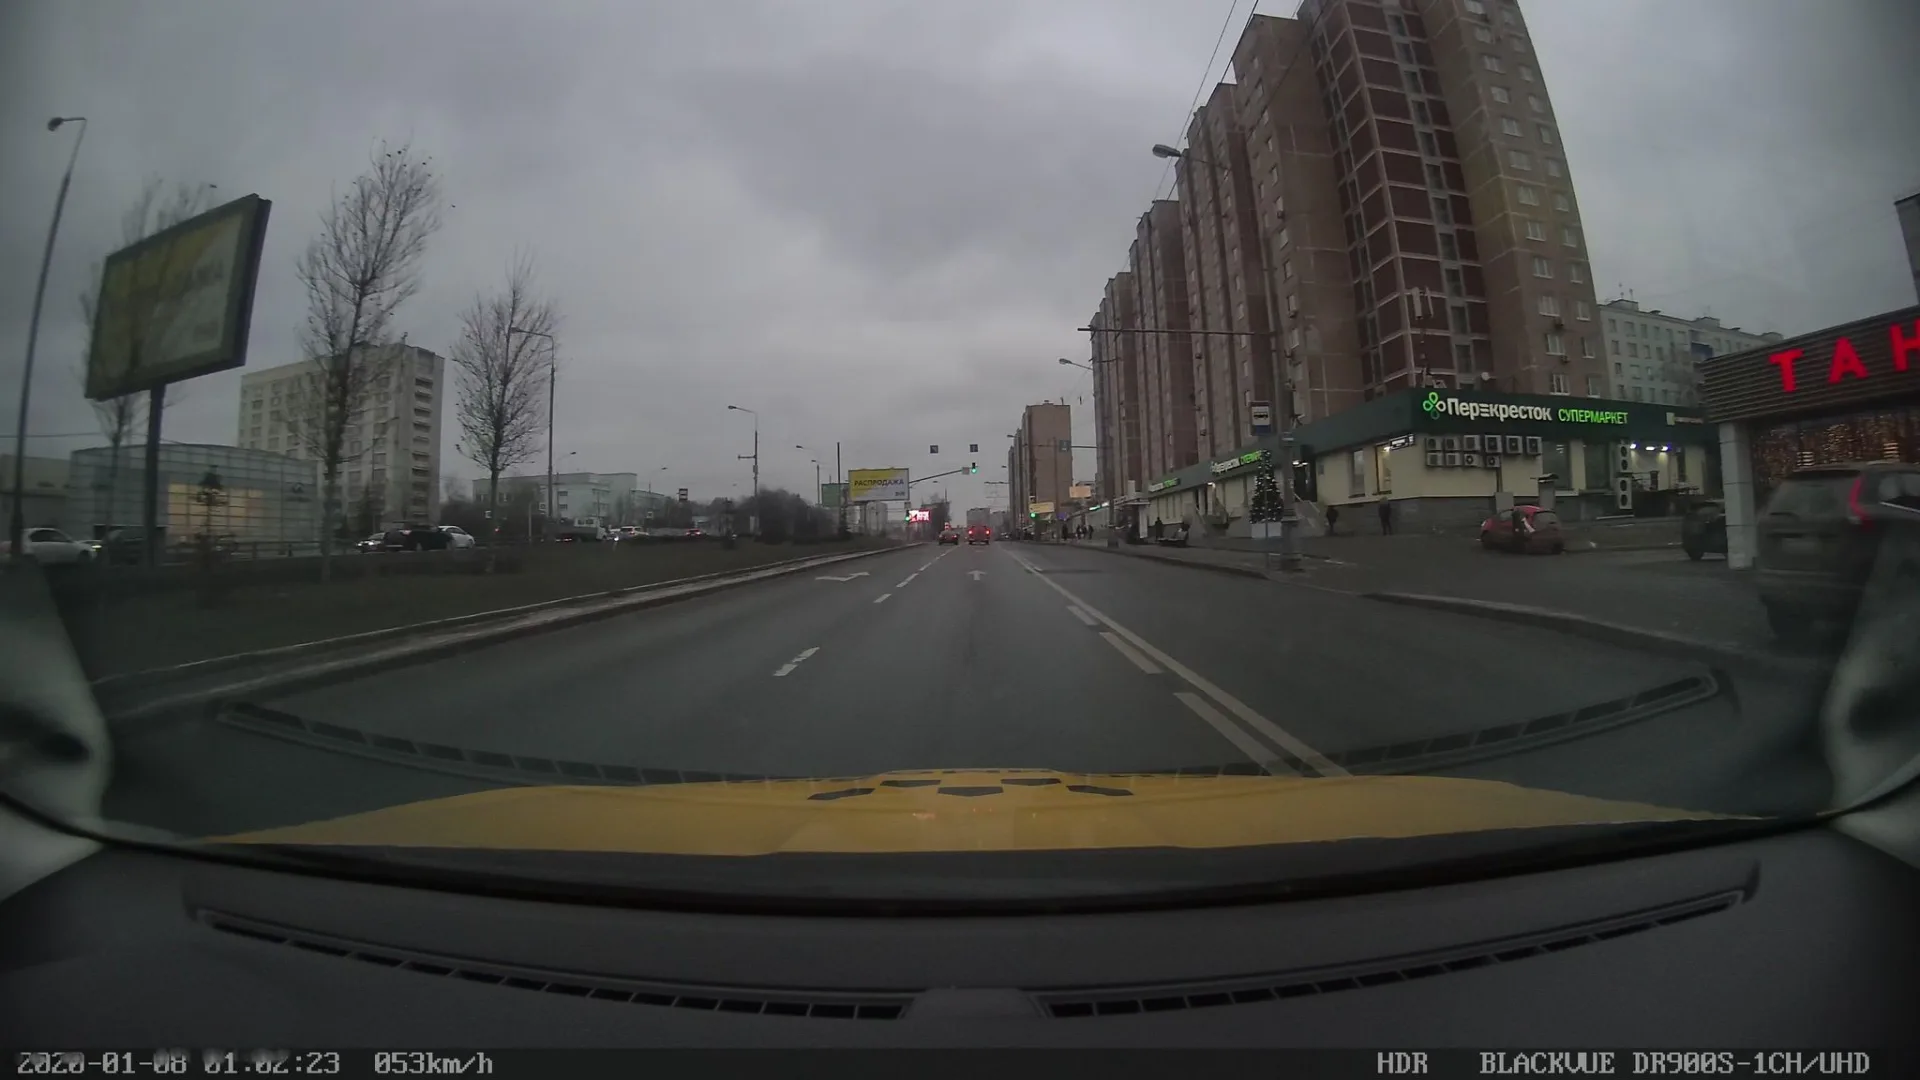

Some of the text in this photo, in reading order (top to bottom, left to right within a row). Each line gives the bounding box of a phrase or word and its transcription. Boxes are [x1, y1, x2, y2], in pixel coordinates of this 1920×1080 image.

[1446, 397, 1629, 425] Перекресток СУПЕРМАРКЕТ
[853, 478, 905, 488] РАСПРОДАЖА
